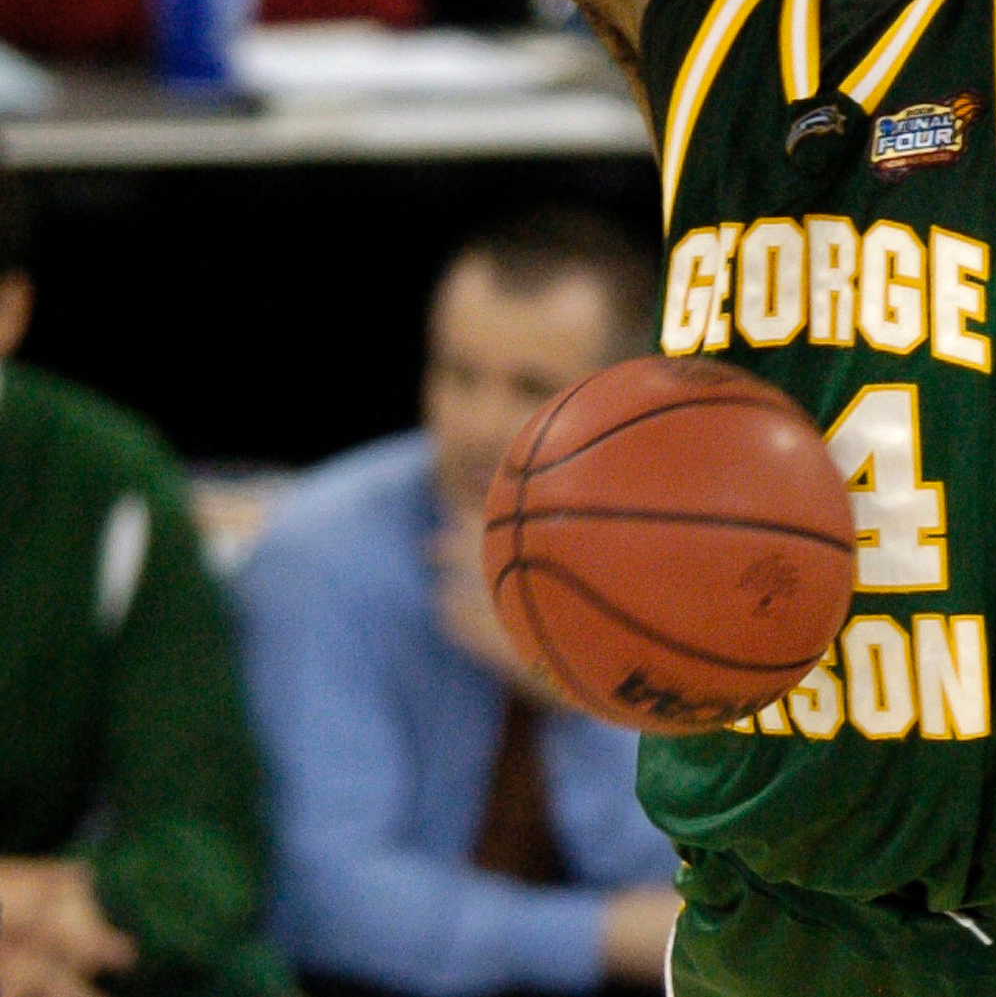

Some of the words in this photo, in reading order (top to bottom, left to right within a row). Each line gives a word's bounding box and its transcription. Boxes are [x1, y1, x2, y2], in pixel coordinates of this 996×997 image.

[893, 115, 952, 133] FINAL
[878, 128, 953, 154] FOUR
[661, 214, 992, 374] GEORGE
